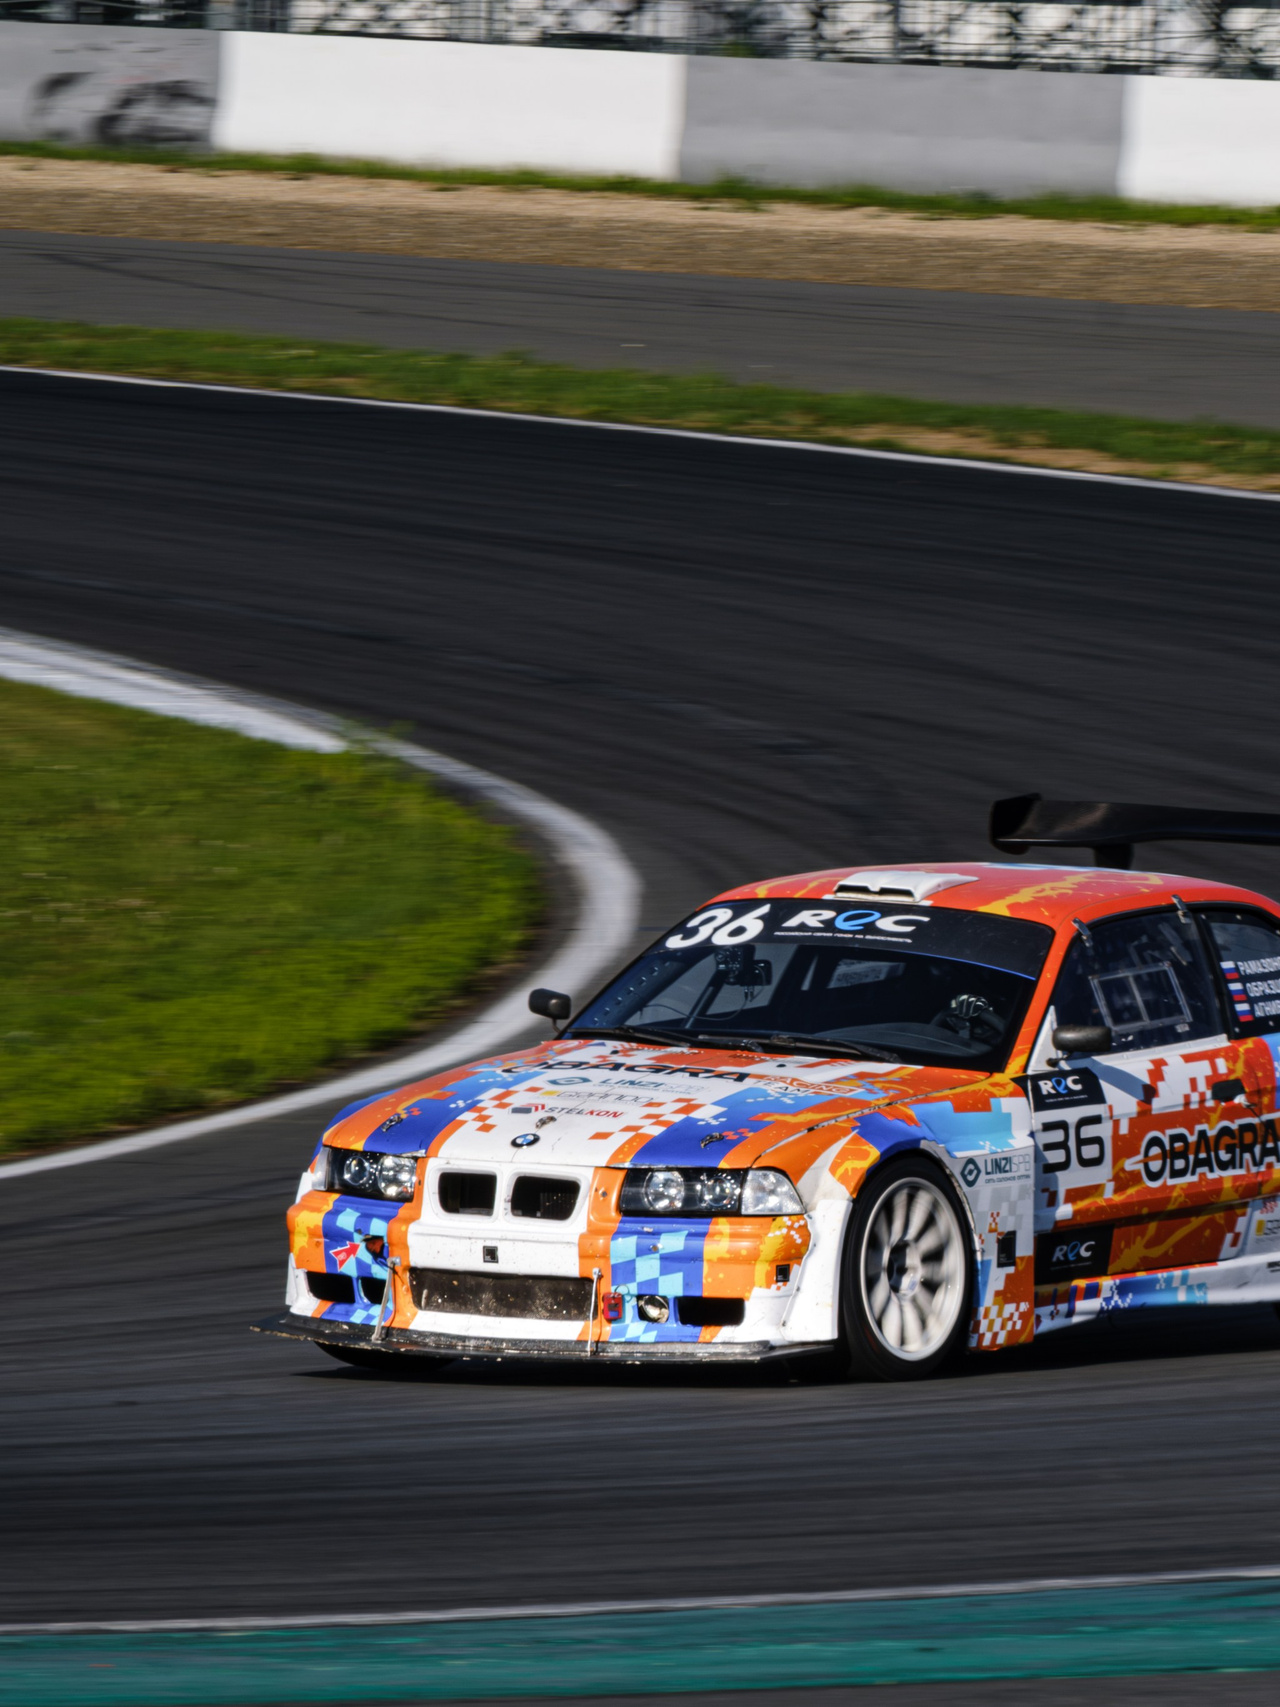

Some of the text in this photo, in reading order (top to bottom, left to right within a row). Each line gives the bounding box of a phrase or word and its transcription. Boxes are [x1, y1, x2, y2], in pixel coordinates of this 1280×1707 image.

[665, 903, 771, 949] 36
[501, 1060, 851, 1094] OBAGRA RACING
[753, 1080, 811, 1094] TEAM
[545, 1106, 625, 1119] STELKON
[1041, 1114, 1105, 1174] 36
